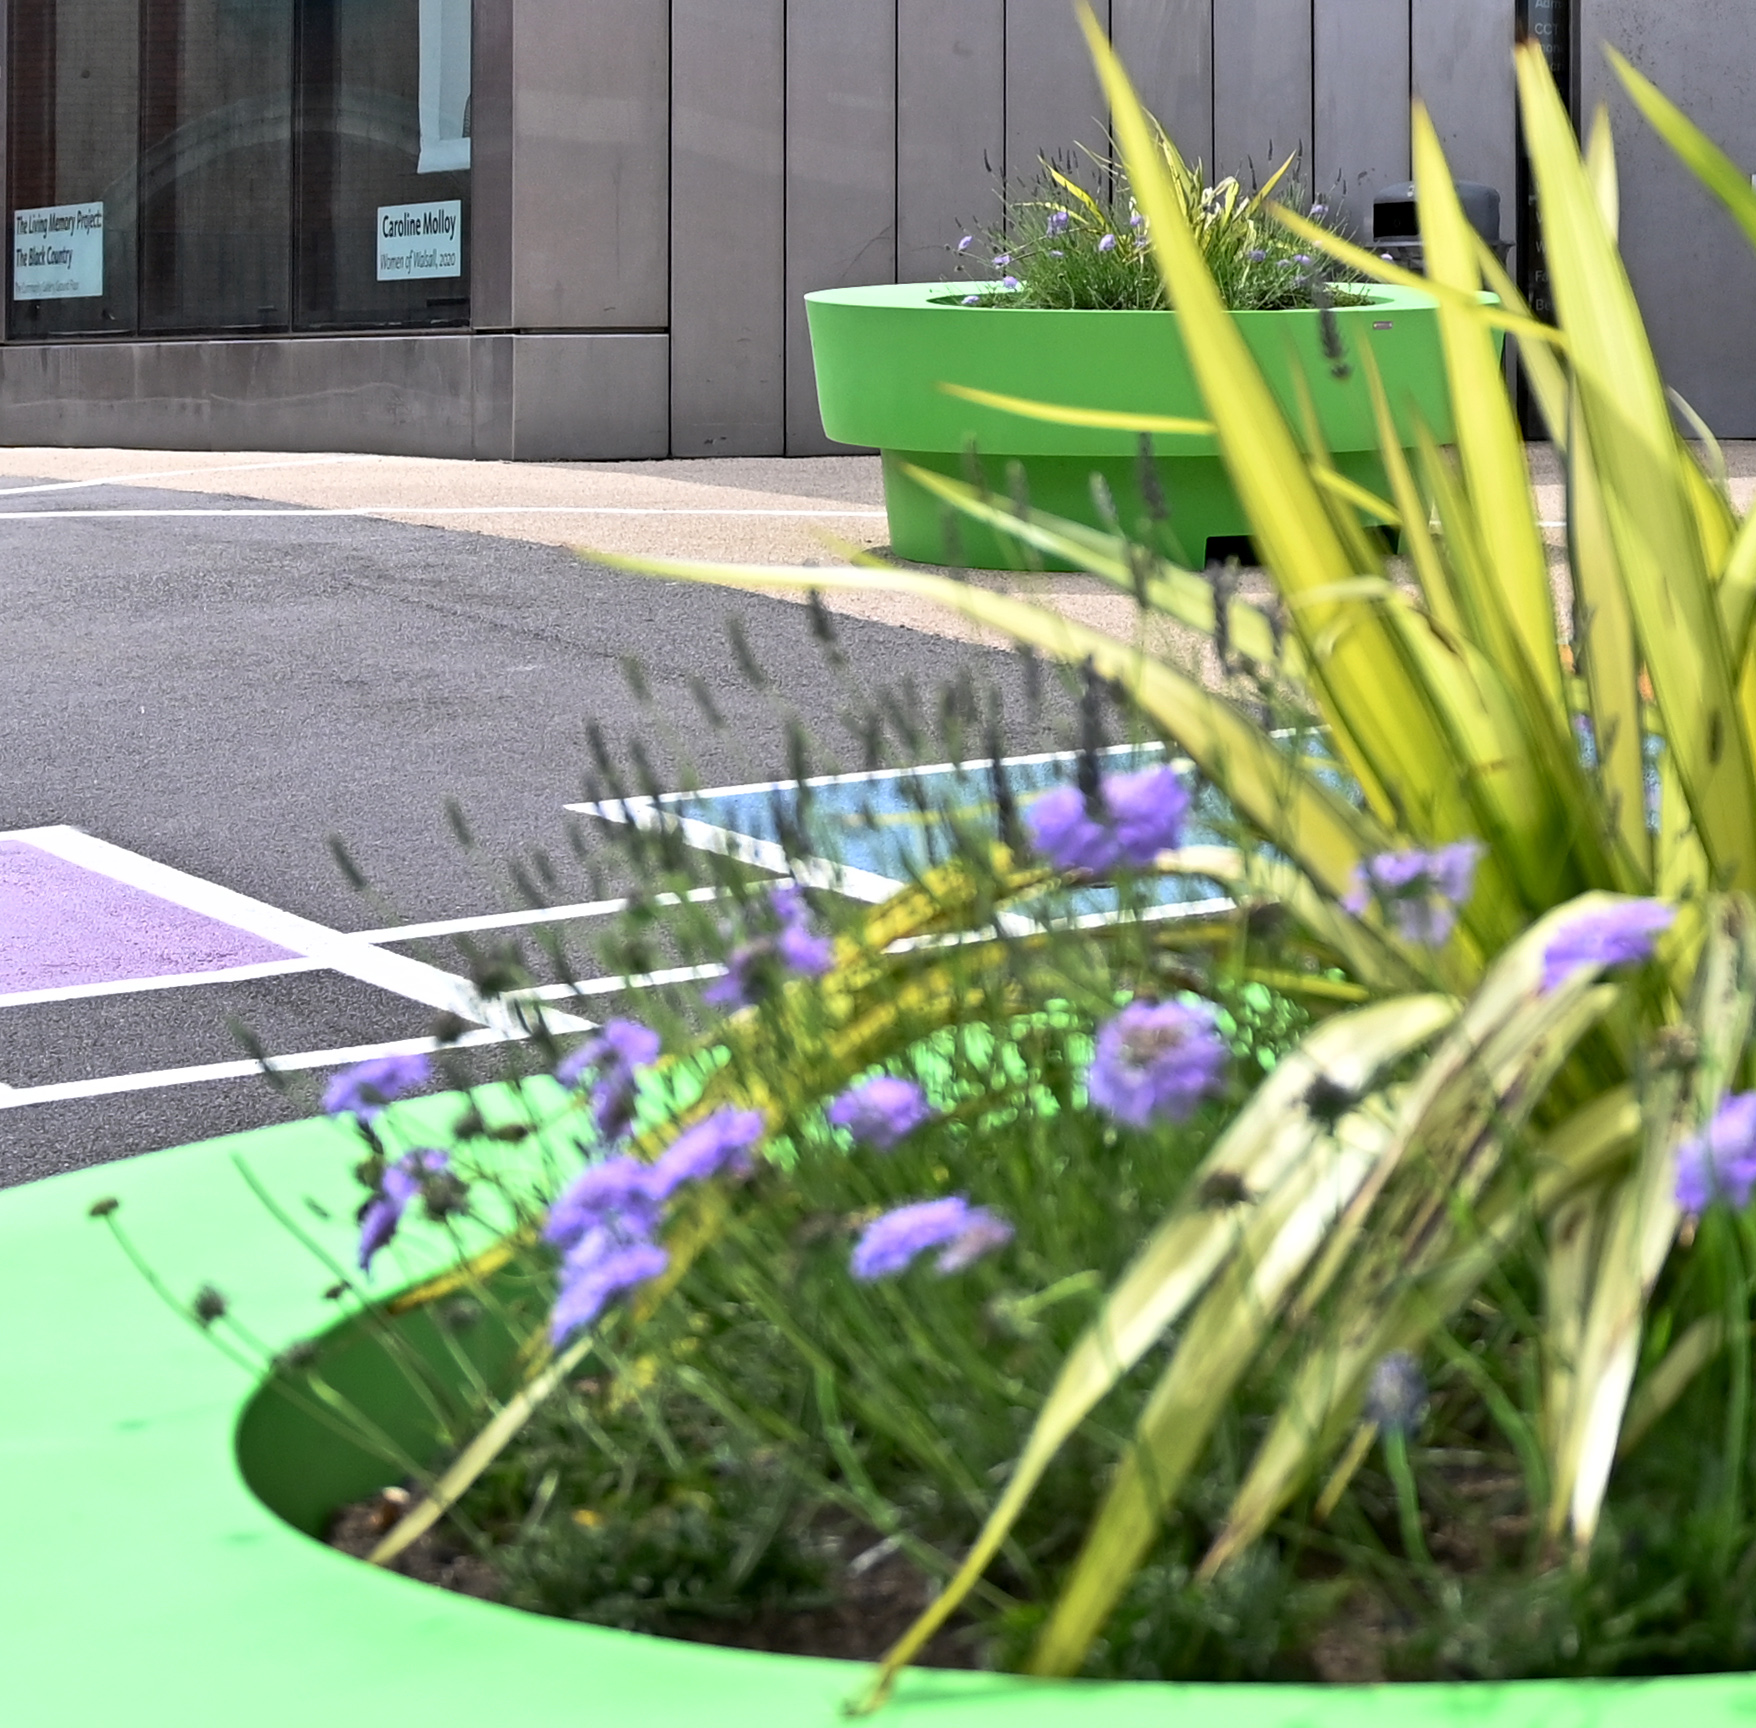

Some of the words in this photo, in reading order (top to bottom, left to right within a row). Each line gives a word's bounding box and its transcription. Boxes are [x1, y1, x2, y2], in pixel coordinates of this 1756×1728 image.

[382, 211, 422, 239] Caroline
[422, 208, 457, 241] Molloy
[380, 252, 404, 270] Women
[405, 249, 414, 275] of
[438, 252, 456, 268] 2020
